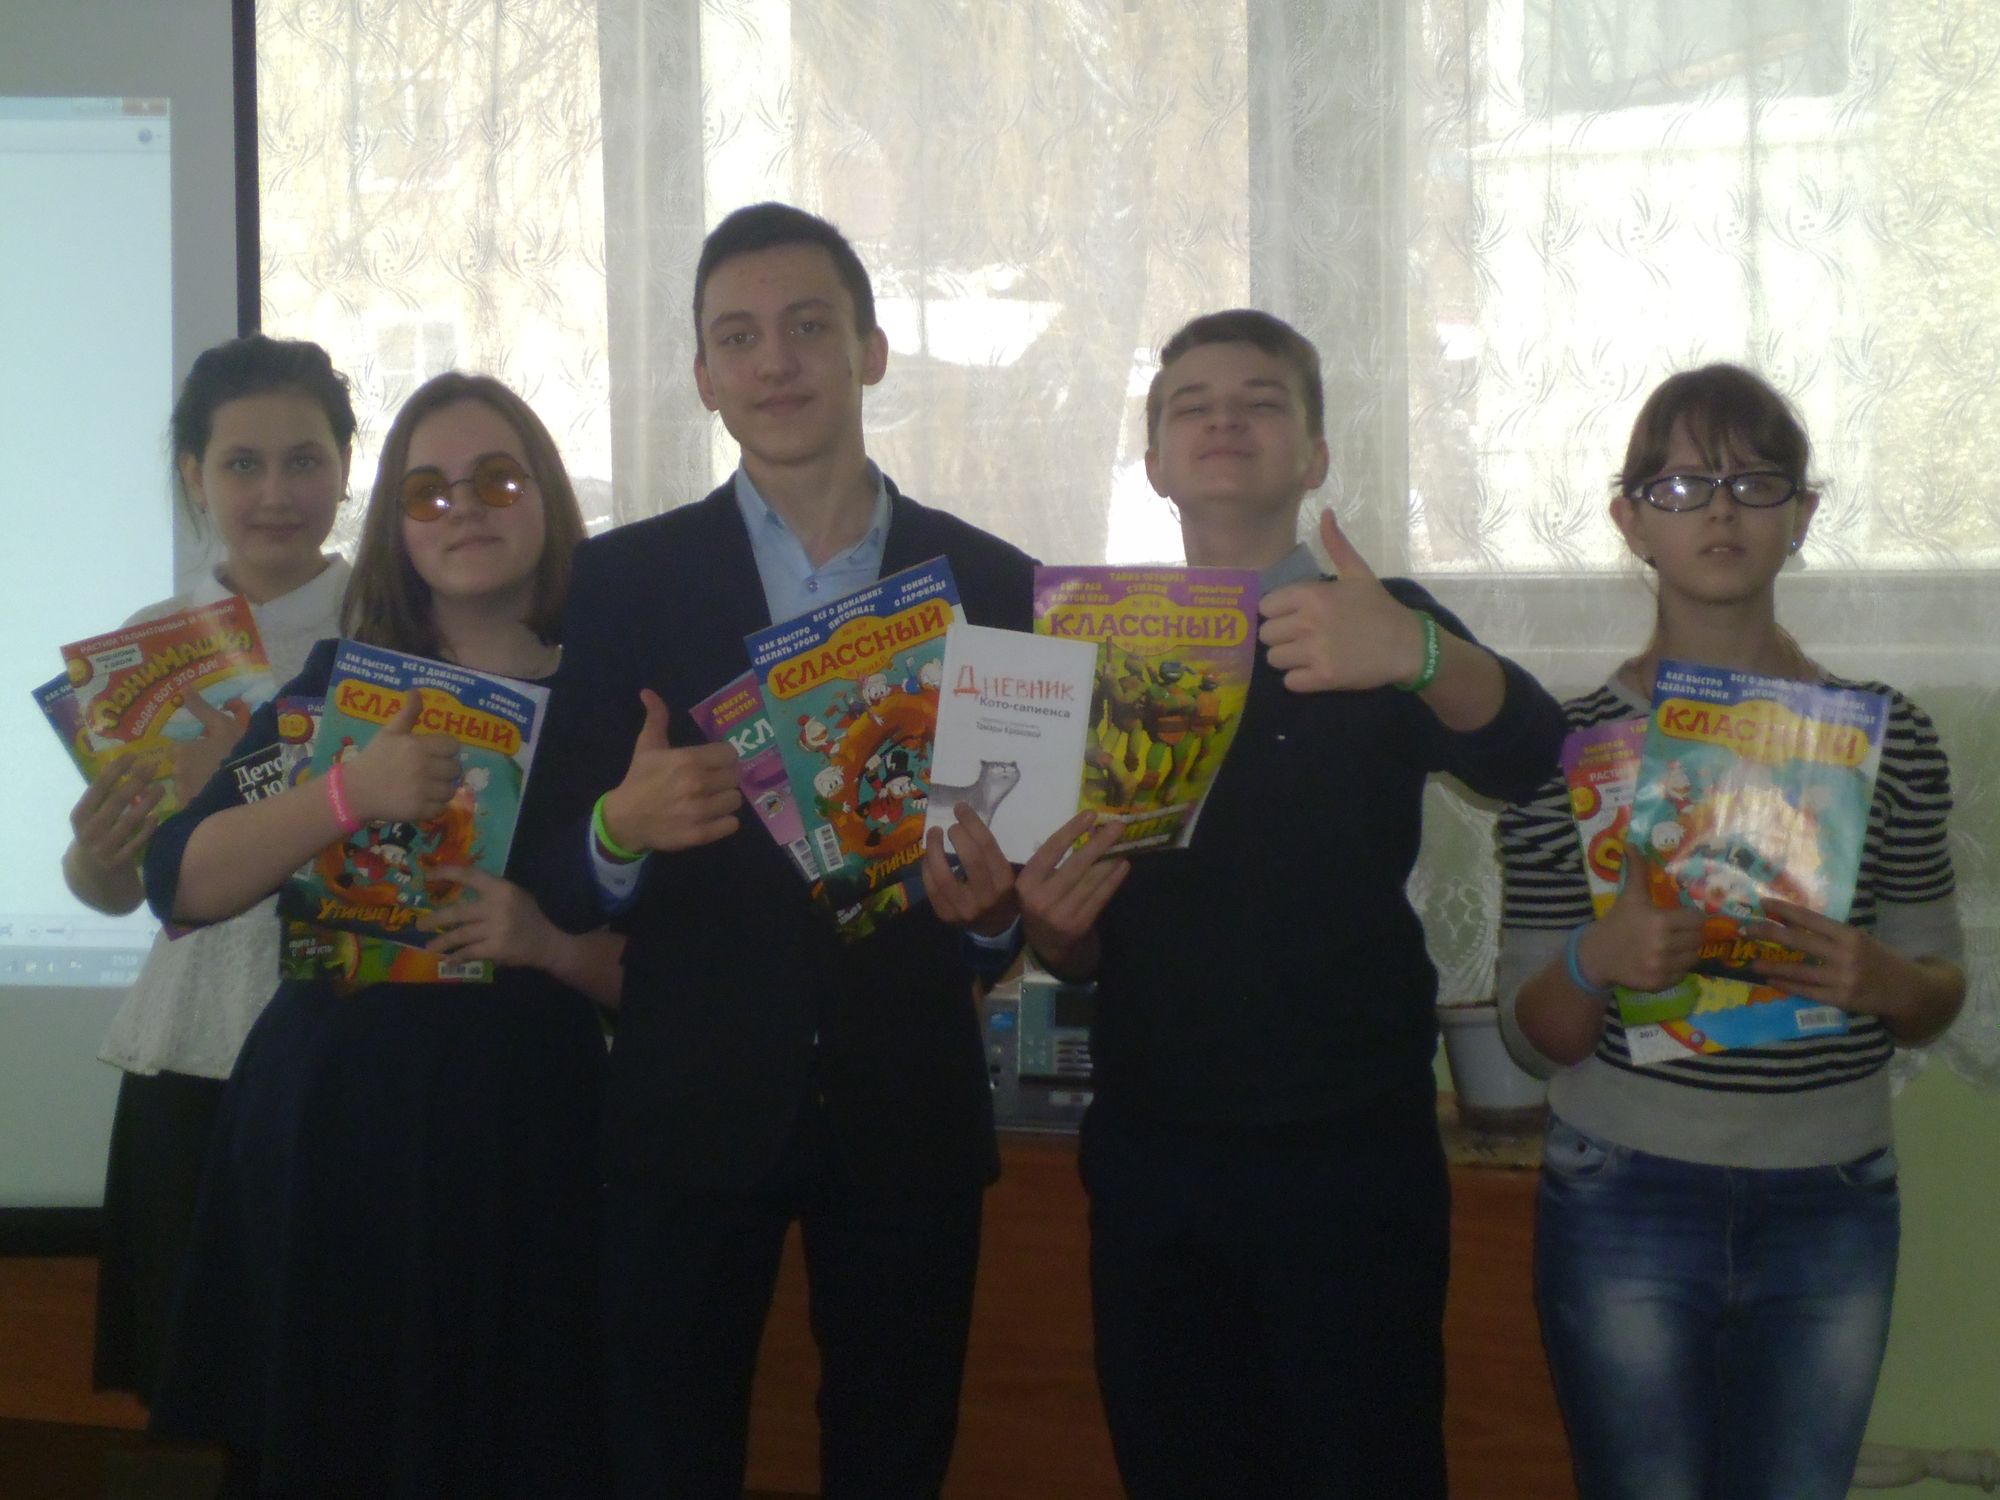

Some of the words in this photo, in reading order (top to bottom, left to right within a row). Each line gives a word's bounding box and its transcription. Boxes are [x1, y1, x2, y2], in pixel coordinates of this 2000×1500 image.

[836, 587, 885, 615] ДОМАШНИХ
[827, 604, 877, 632] ПИТОМЦАХ
[1051, 612, 1237, 640] КЛАССНЫЙ
[754, 645, 792, 666] СДЕЛАТЬ
[794, 632, 821, 651] УРОКИ
[758, 638, 776, 653] КАК
[777, 626, 811, 648] БЫСТРО
[773, 604, 946, 695] КЛАССНЫЙ
[336, 660, 372, 678] СДЕЛАТЬ
[373, 671, 401, 686] УРОКИ
[361, 656, 396, 673] БЫСТРО
[426, 666, 477, 687] ДОМАШНИХ
[153, 682, 175, 703] ВОТ
[173, 668, 195, 687] ЭТО
[197, 658, 219, 677] ДА!
[411, 676, 463, 700] ПИТОМЦАХ
[1656, 681, 1697, 695] СДЕЛАТЬ
[1698, 688, 1730, 700] УРОКИ
[1666, 671, 1684, 684] КАК
[1685, 673, 1724, 688] БЫСТРО
[340, 684, 514, 745] КЛАСНЫЙ
[979, 696, 1071, 719] Кото-сапиенса
[728, 717, 775, 758] КЛ
